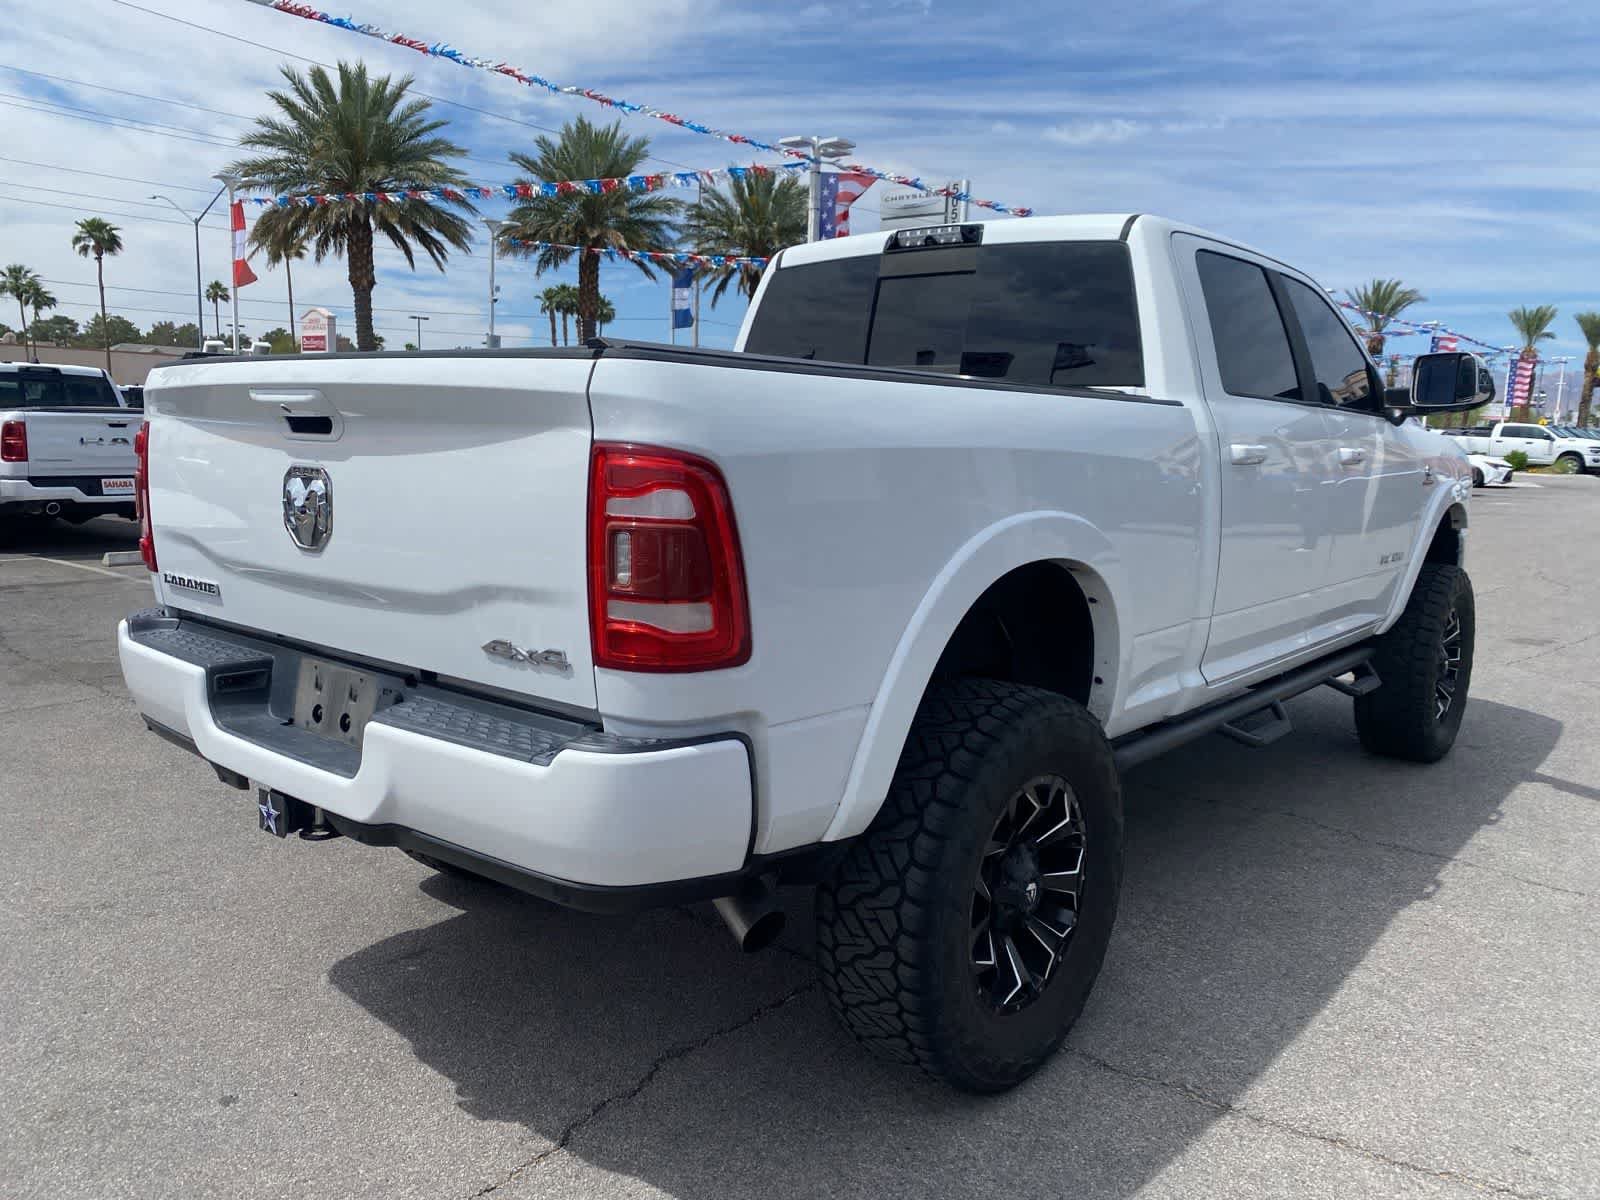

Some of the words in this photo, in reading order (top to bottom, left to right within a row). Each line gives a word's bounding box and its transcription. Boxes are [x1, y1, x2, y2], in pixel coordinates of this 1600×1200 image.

[884, 190, 940, 202] CHRYSLER
[951, 183, 960, 224] 505
[103, 479, 133, 488] SAHARA
[163, 573, 216, 594] LARAMIE
